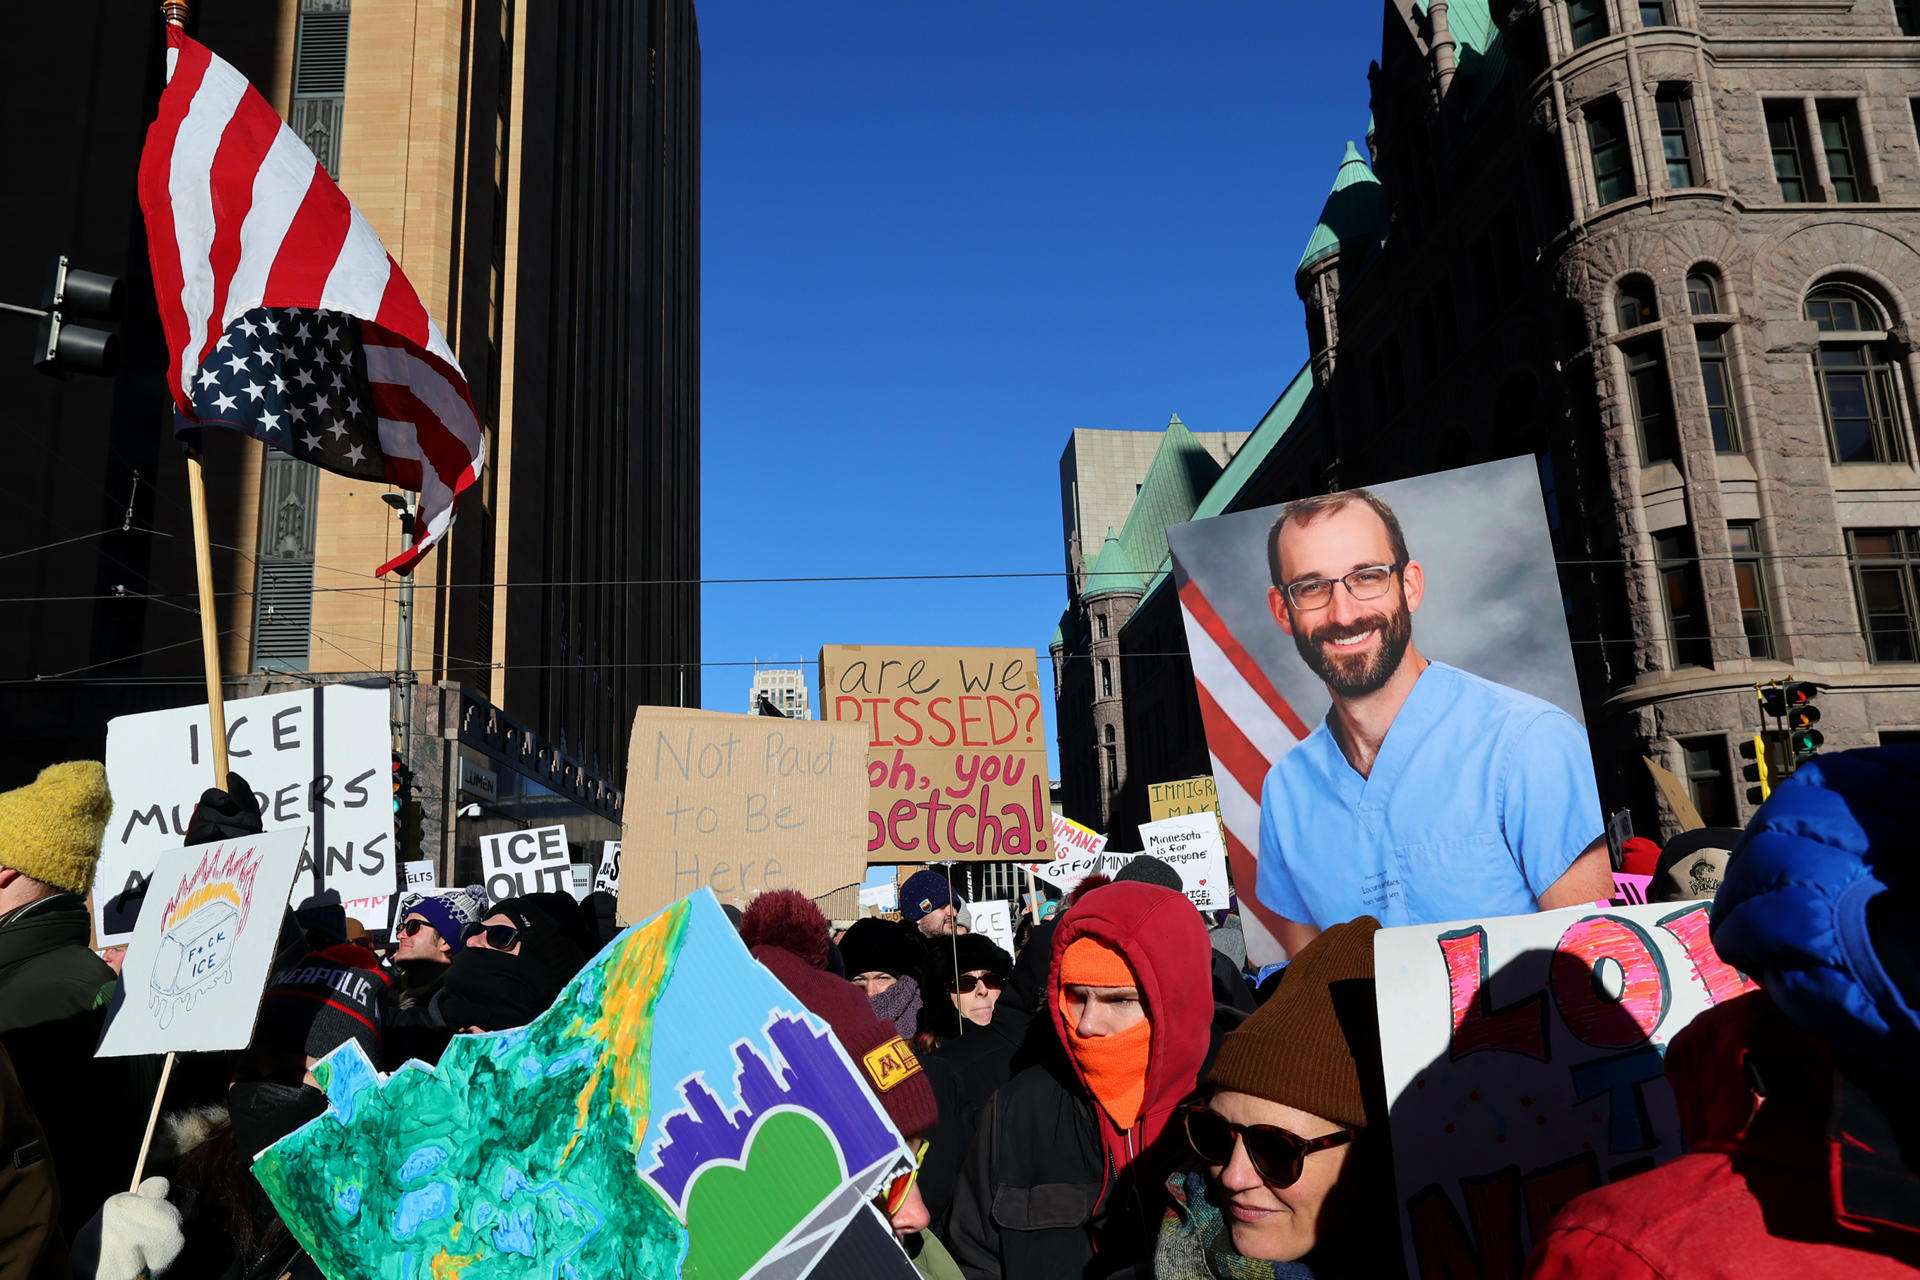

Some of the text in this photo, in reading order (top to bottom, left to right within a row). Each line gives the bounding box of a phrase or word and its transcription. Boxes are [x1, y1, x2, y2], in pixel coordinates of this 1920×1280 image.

[839, 659, 1026, 694] are we
[190, 706, 302, 765] ICE
[655, 727, 835, 782] Not Paid
[945, 754, 1026, 799] you
[665, 793, 806, 836] to Be
[490, 828, 564, 868] ICE
[1150, 830, 1201, 847] Minnesota
[1156, 844, 1187, 855] is for
[405, 871, 433, 885] ELTS
[486, 863, 571, 904] OUT
[673, 850, 782, 901] Here
[192, 952, 217, 978] ICE
